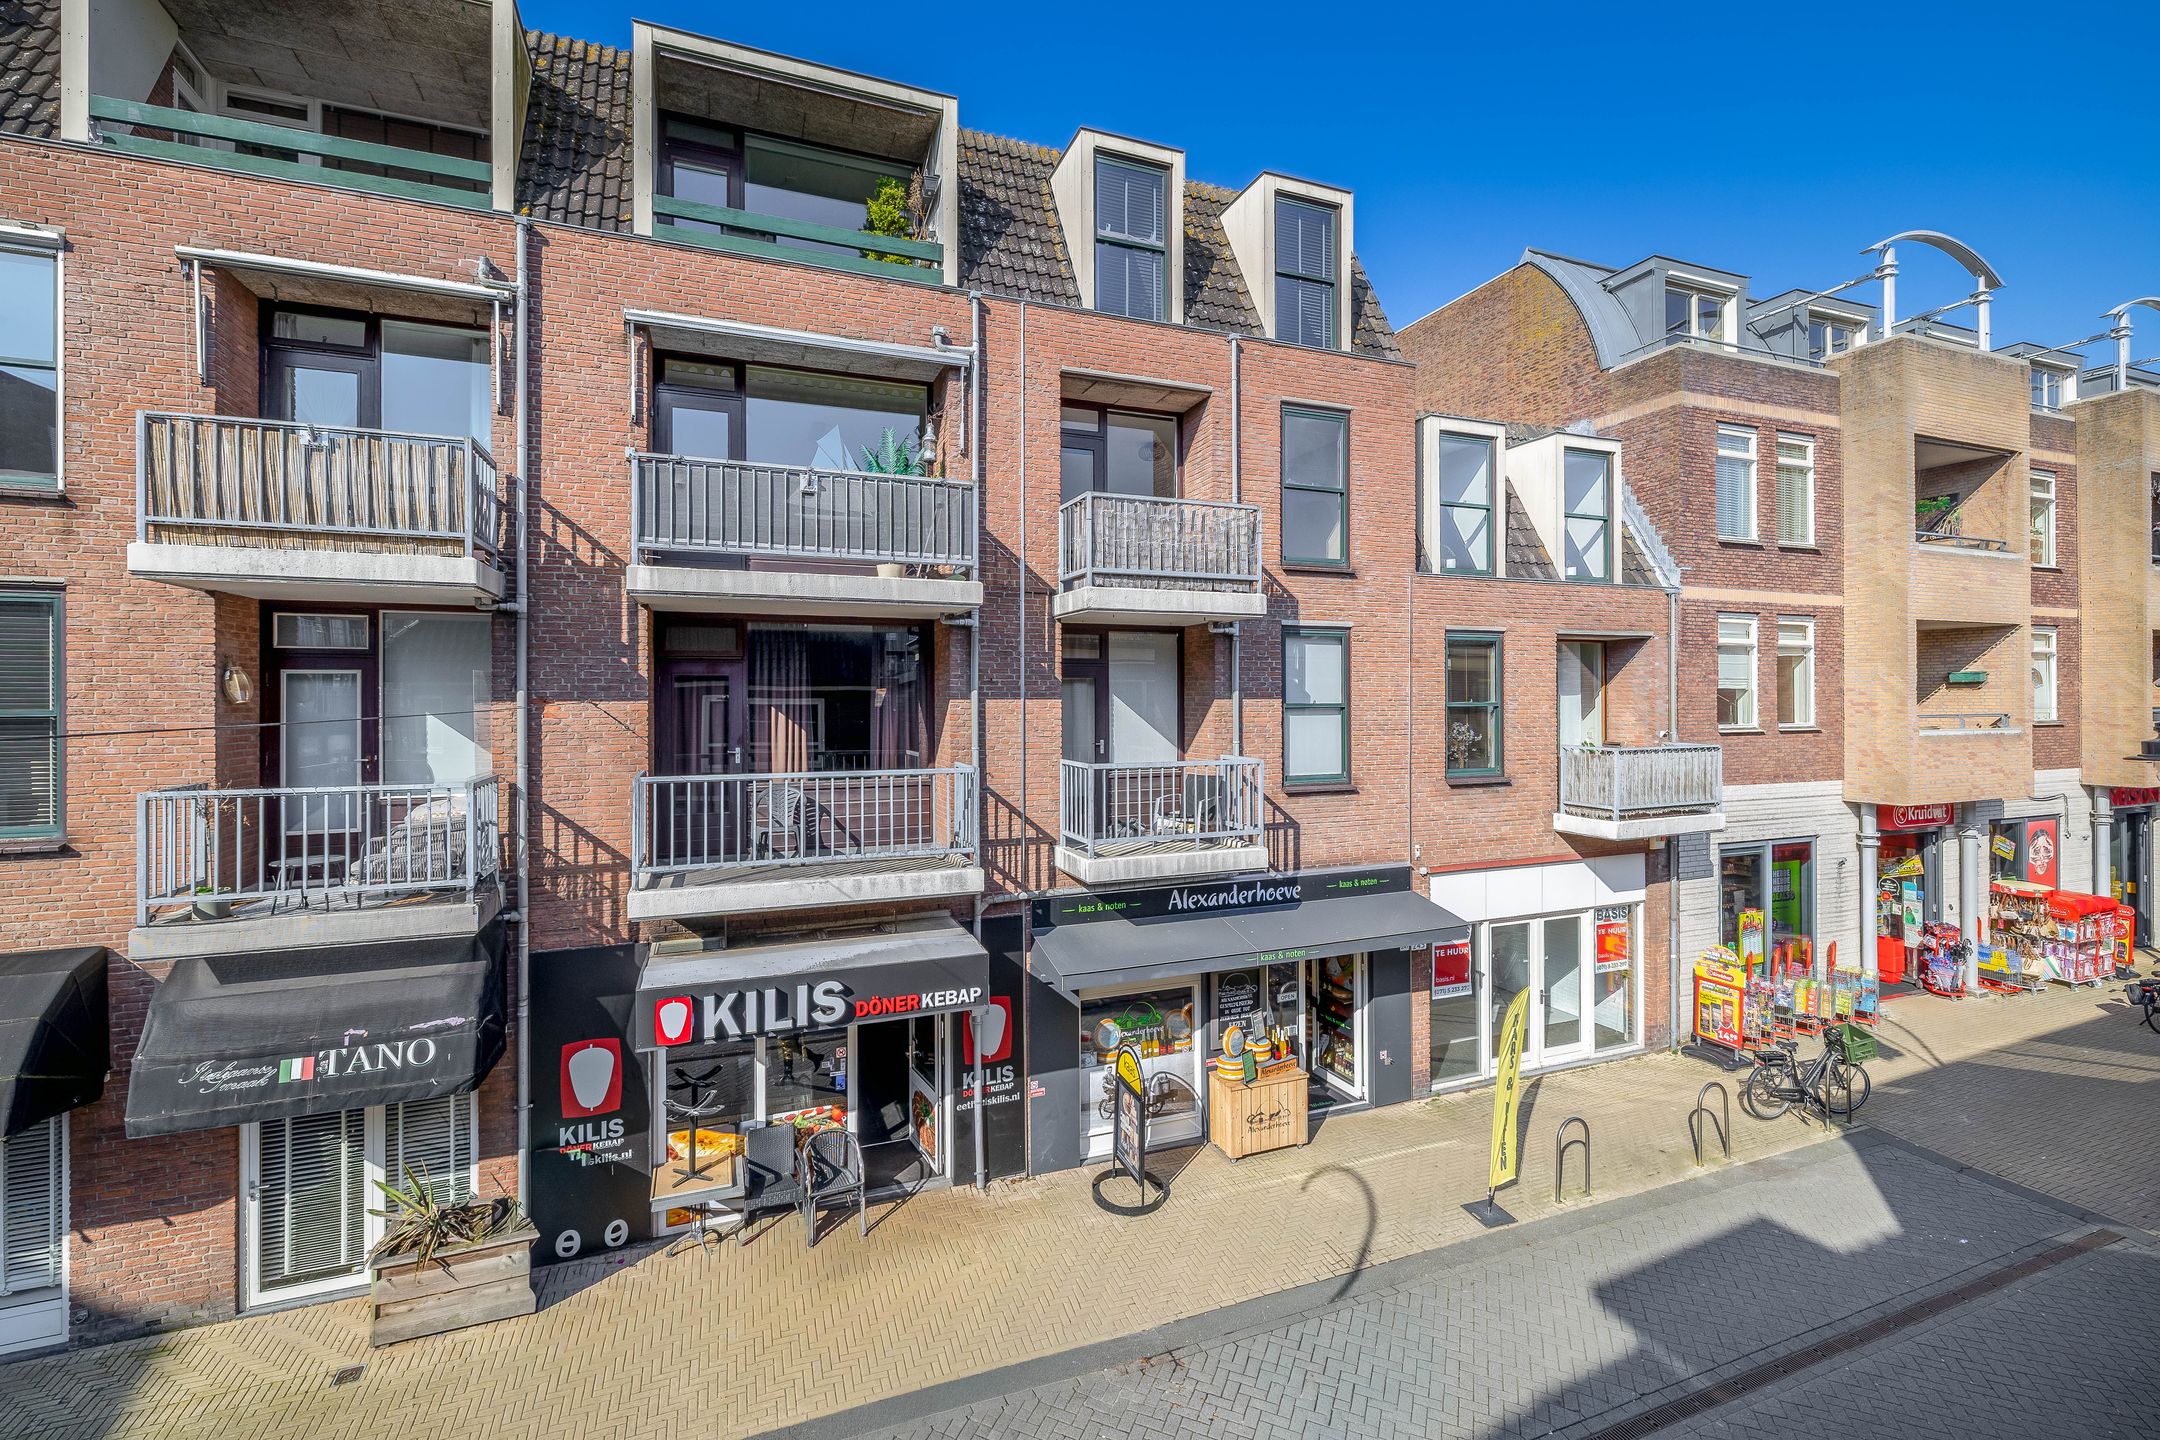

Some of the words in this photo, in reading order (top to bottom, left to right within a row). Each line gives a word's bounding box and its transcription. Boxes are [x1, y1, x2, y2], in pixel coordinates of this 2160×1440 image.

[1908, 806, 1947, 820] Kruidvat
[1339, 880, 1354, 888] kaas
[1168, 882, 1301, 911] Alexanderhoeve
[1078, 903, 1096, 913] kaas
[1097, 903, 1104, 912] &
[1105, 902, 1127, 911] noten
[1597, 906, 1627, 921] BASIS
[1260, 950, 1276, 961] kaas
[1278, 950, 1284, 959] &
[1286, 949, 1306, 958] noten
[1435, 949, 1445, 957] TE
[1447, 947, 1469, 956] HUUR
[1436, 975, 1455, 983] basis.nl
[703, 980, 847, 1041] KILIS
[319, 1038, 436, 1079] TANO
[990, 1082, 1014, 1092] KEBAP
[559, 1118, 625, 1147] KILIS
